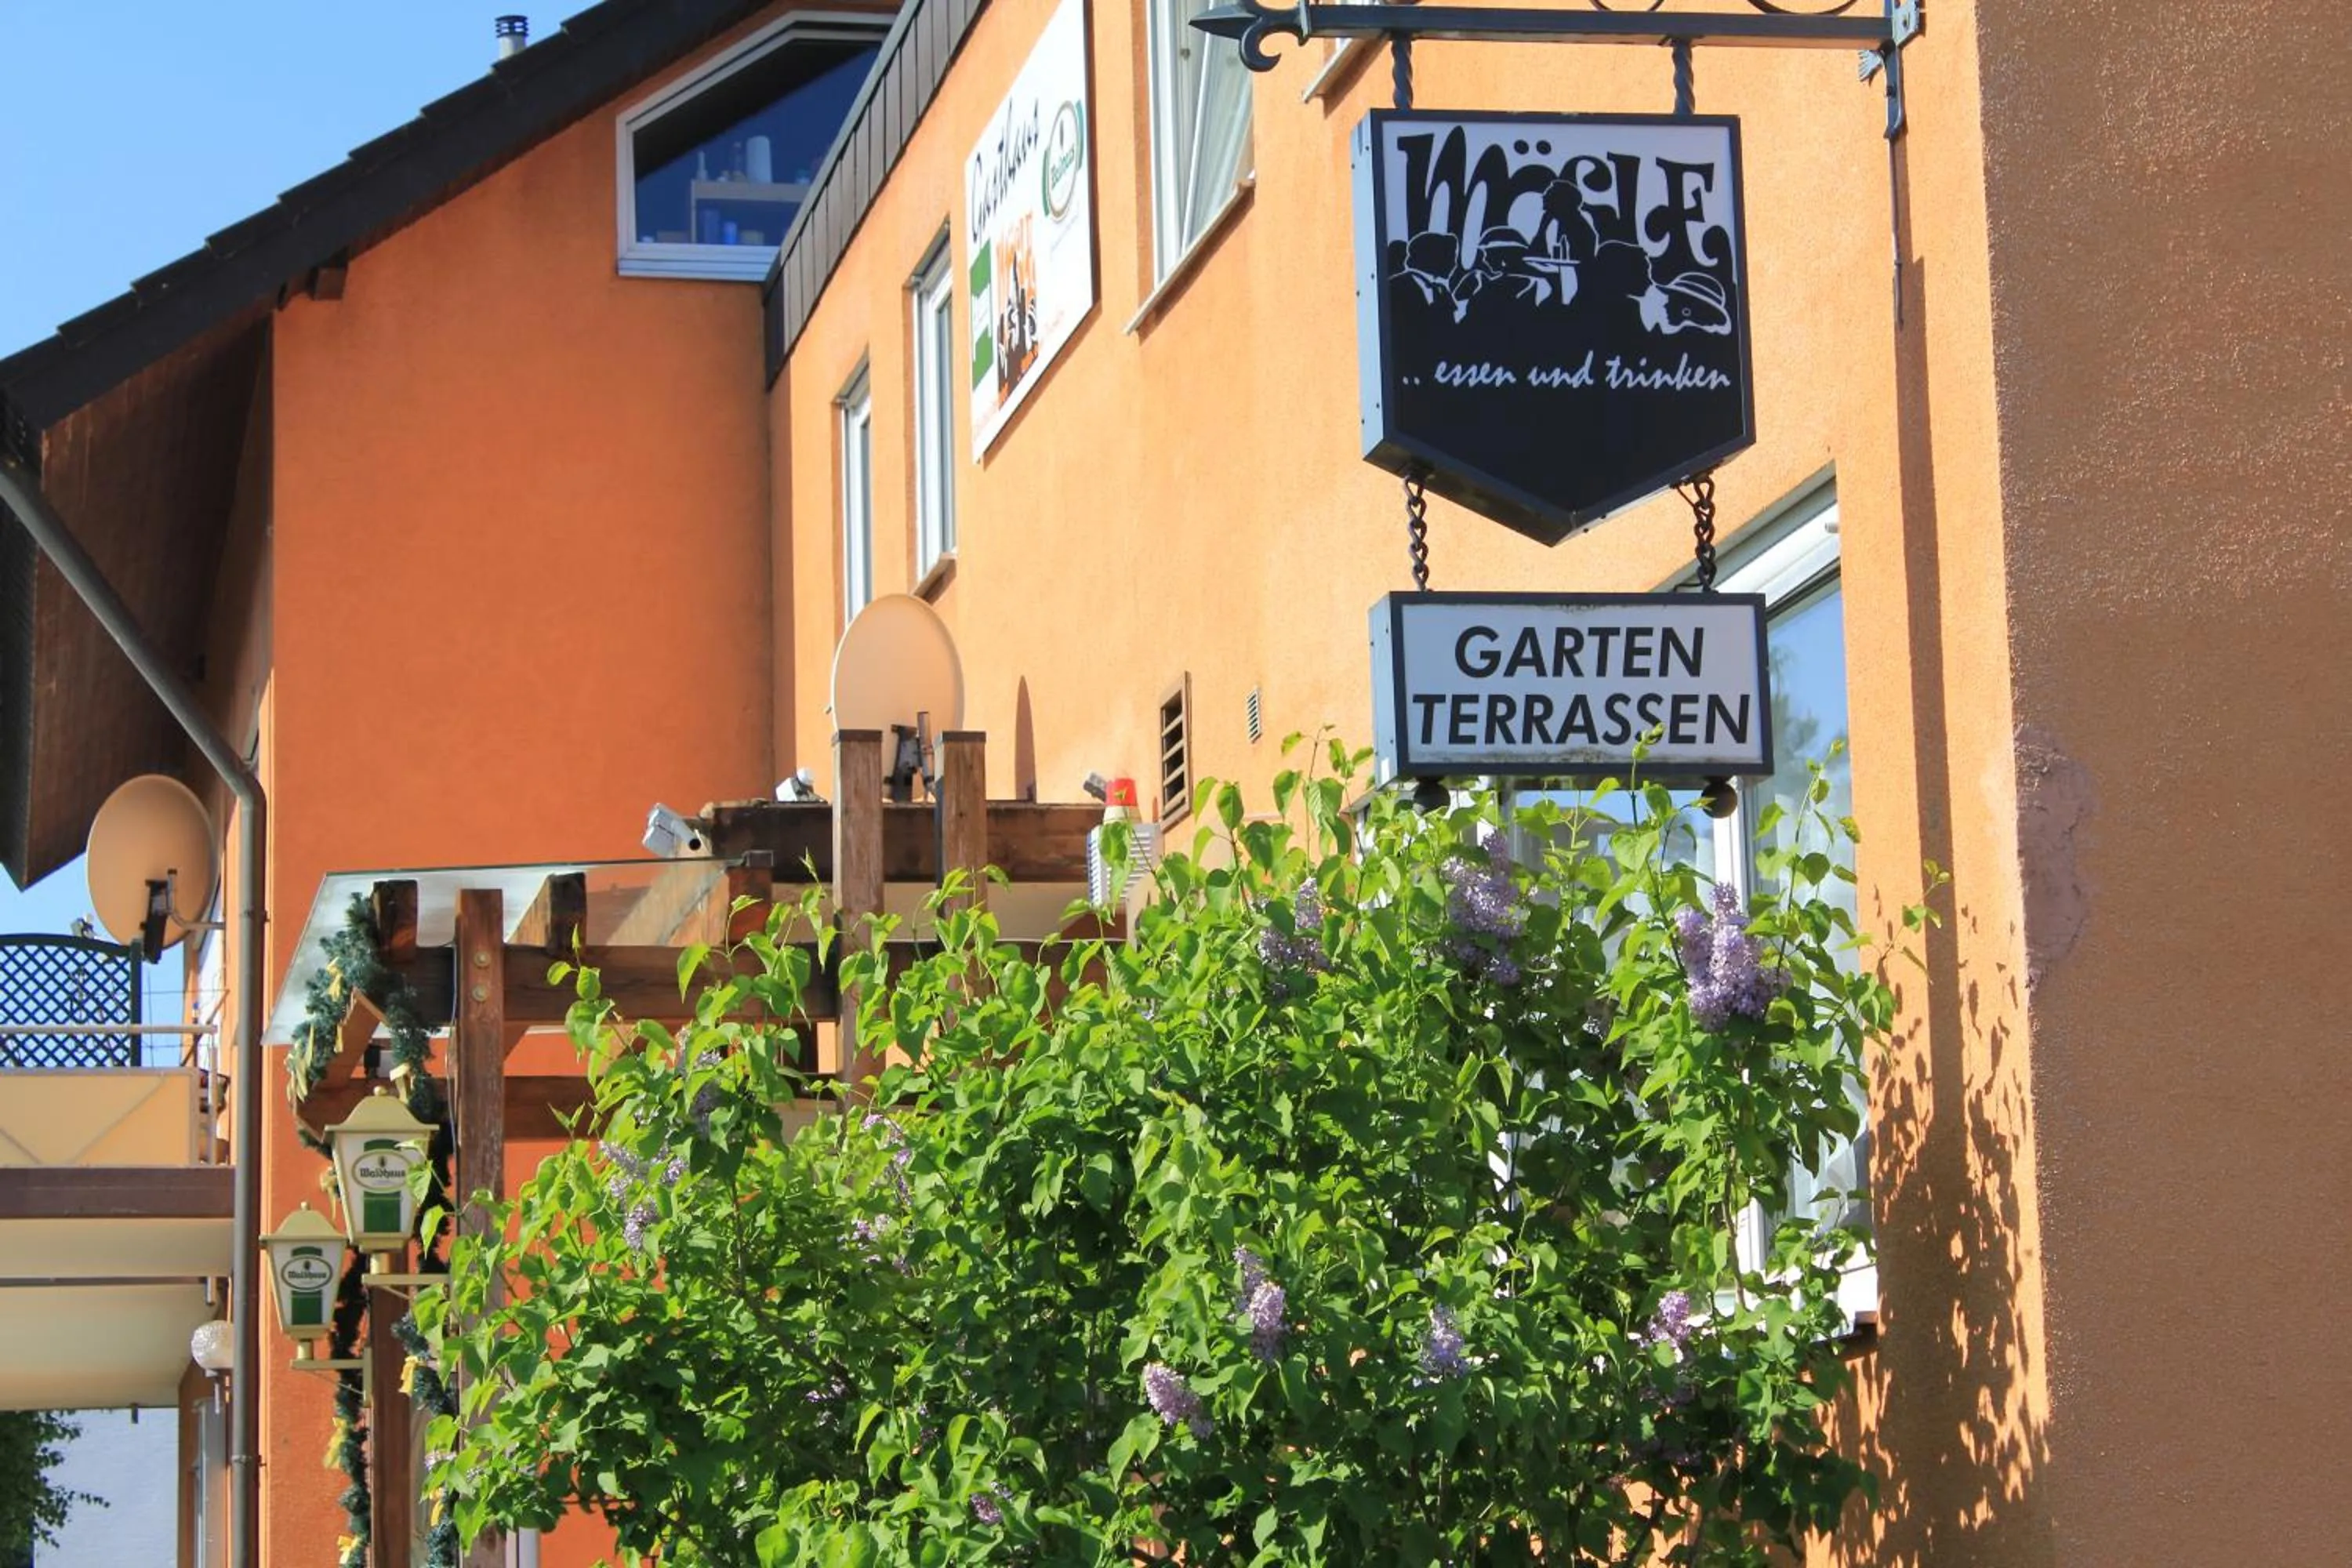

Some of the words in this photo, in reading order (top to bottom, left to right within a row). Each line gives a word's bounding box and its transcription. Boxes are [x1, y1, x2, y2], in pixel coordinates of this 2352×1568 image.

[1434, 360, 1516, 384] essen
[1527, 350, 1594, 387] und
[1605, 353, 1731, 390] trinken
[1454, 625, 1704, 679] GARTEN
[1412, 692, 1751, 745] TERRASSEN
